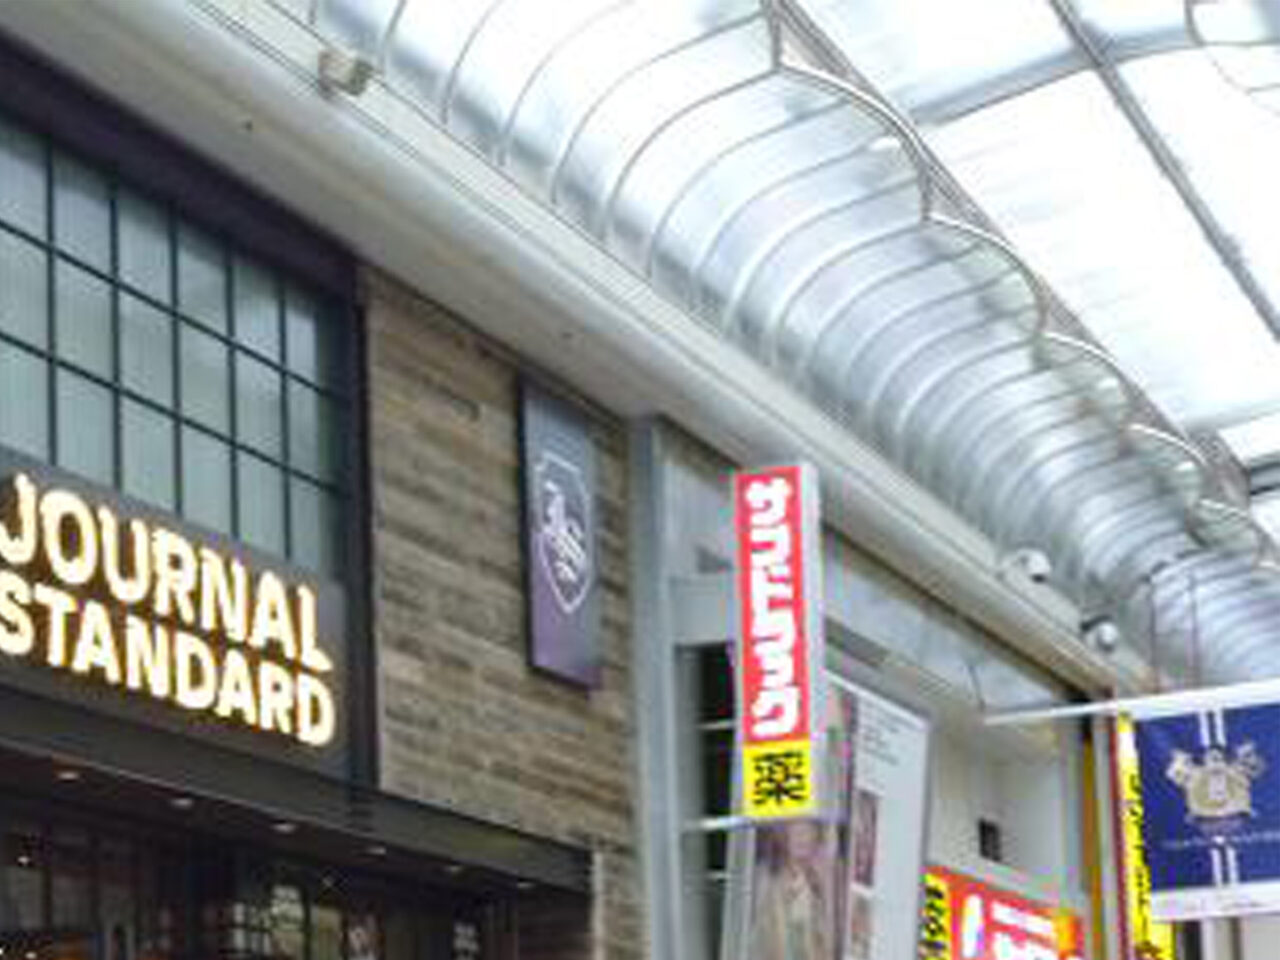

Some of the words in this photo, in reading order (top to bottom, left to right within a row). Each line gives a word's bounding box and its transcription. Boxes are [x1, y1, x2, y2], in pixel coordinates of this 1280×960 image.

[745, 477, 800, 738] サンドラッグ
[752, 748, 808, 806] 薬
